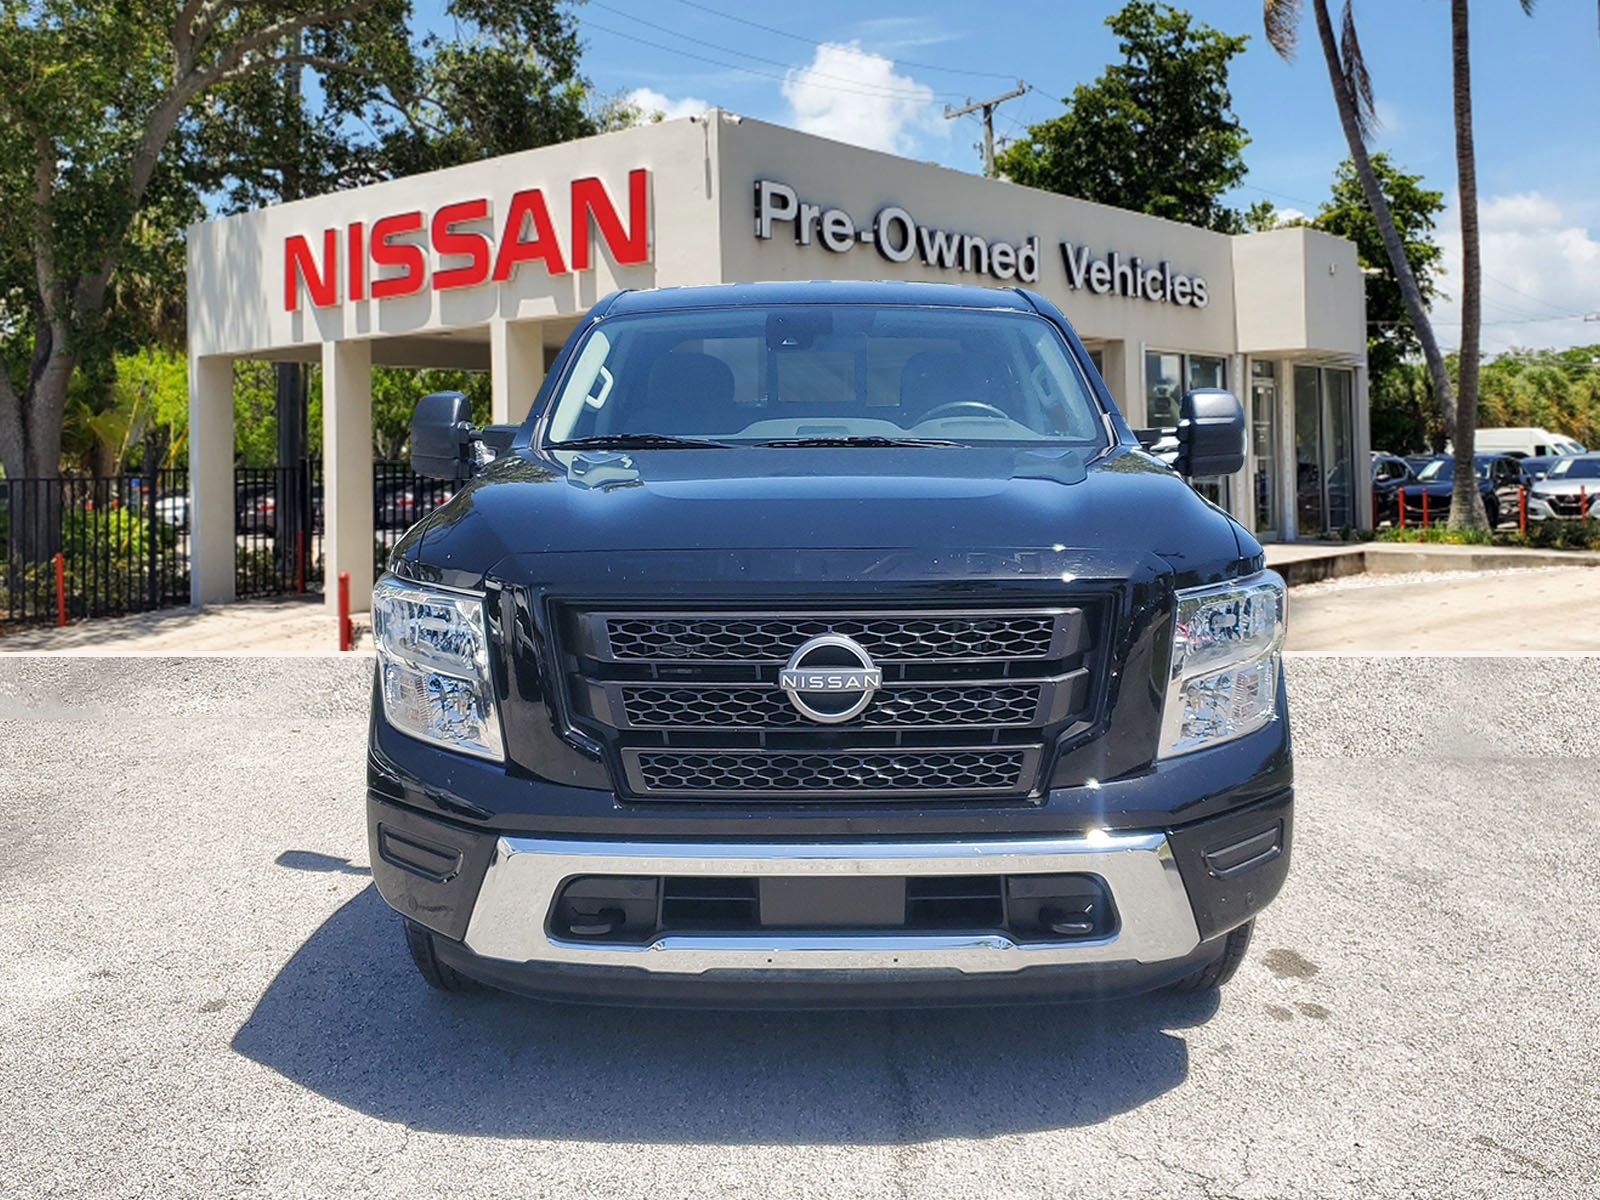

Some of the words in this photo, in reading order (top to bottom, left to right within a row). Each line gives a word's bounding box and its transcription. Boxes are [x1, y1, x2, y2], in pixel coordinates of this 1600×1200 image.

[285, 168, 647, 312] NISSAN
[755, 180, 1039, 283] Pre-Owned
[1060, 241, 1209, 308] Vehicles
[782, 675, 880, 689] NISSAN
